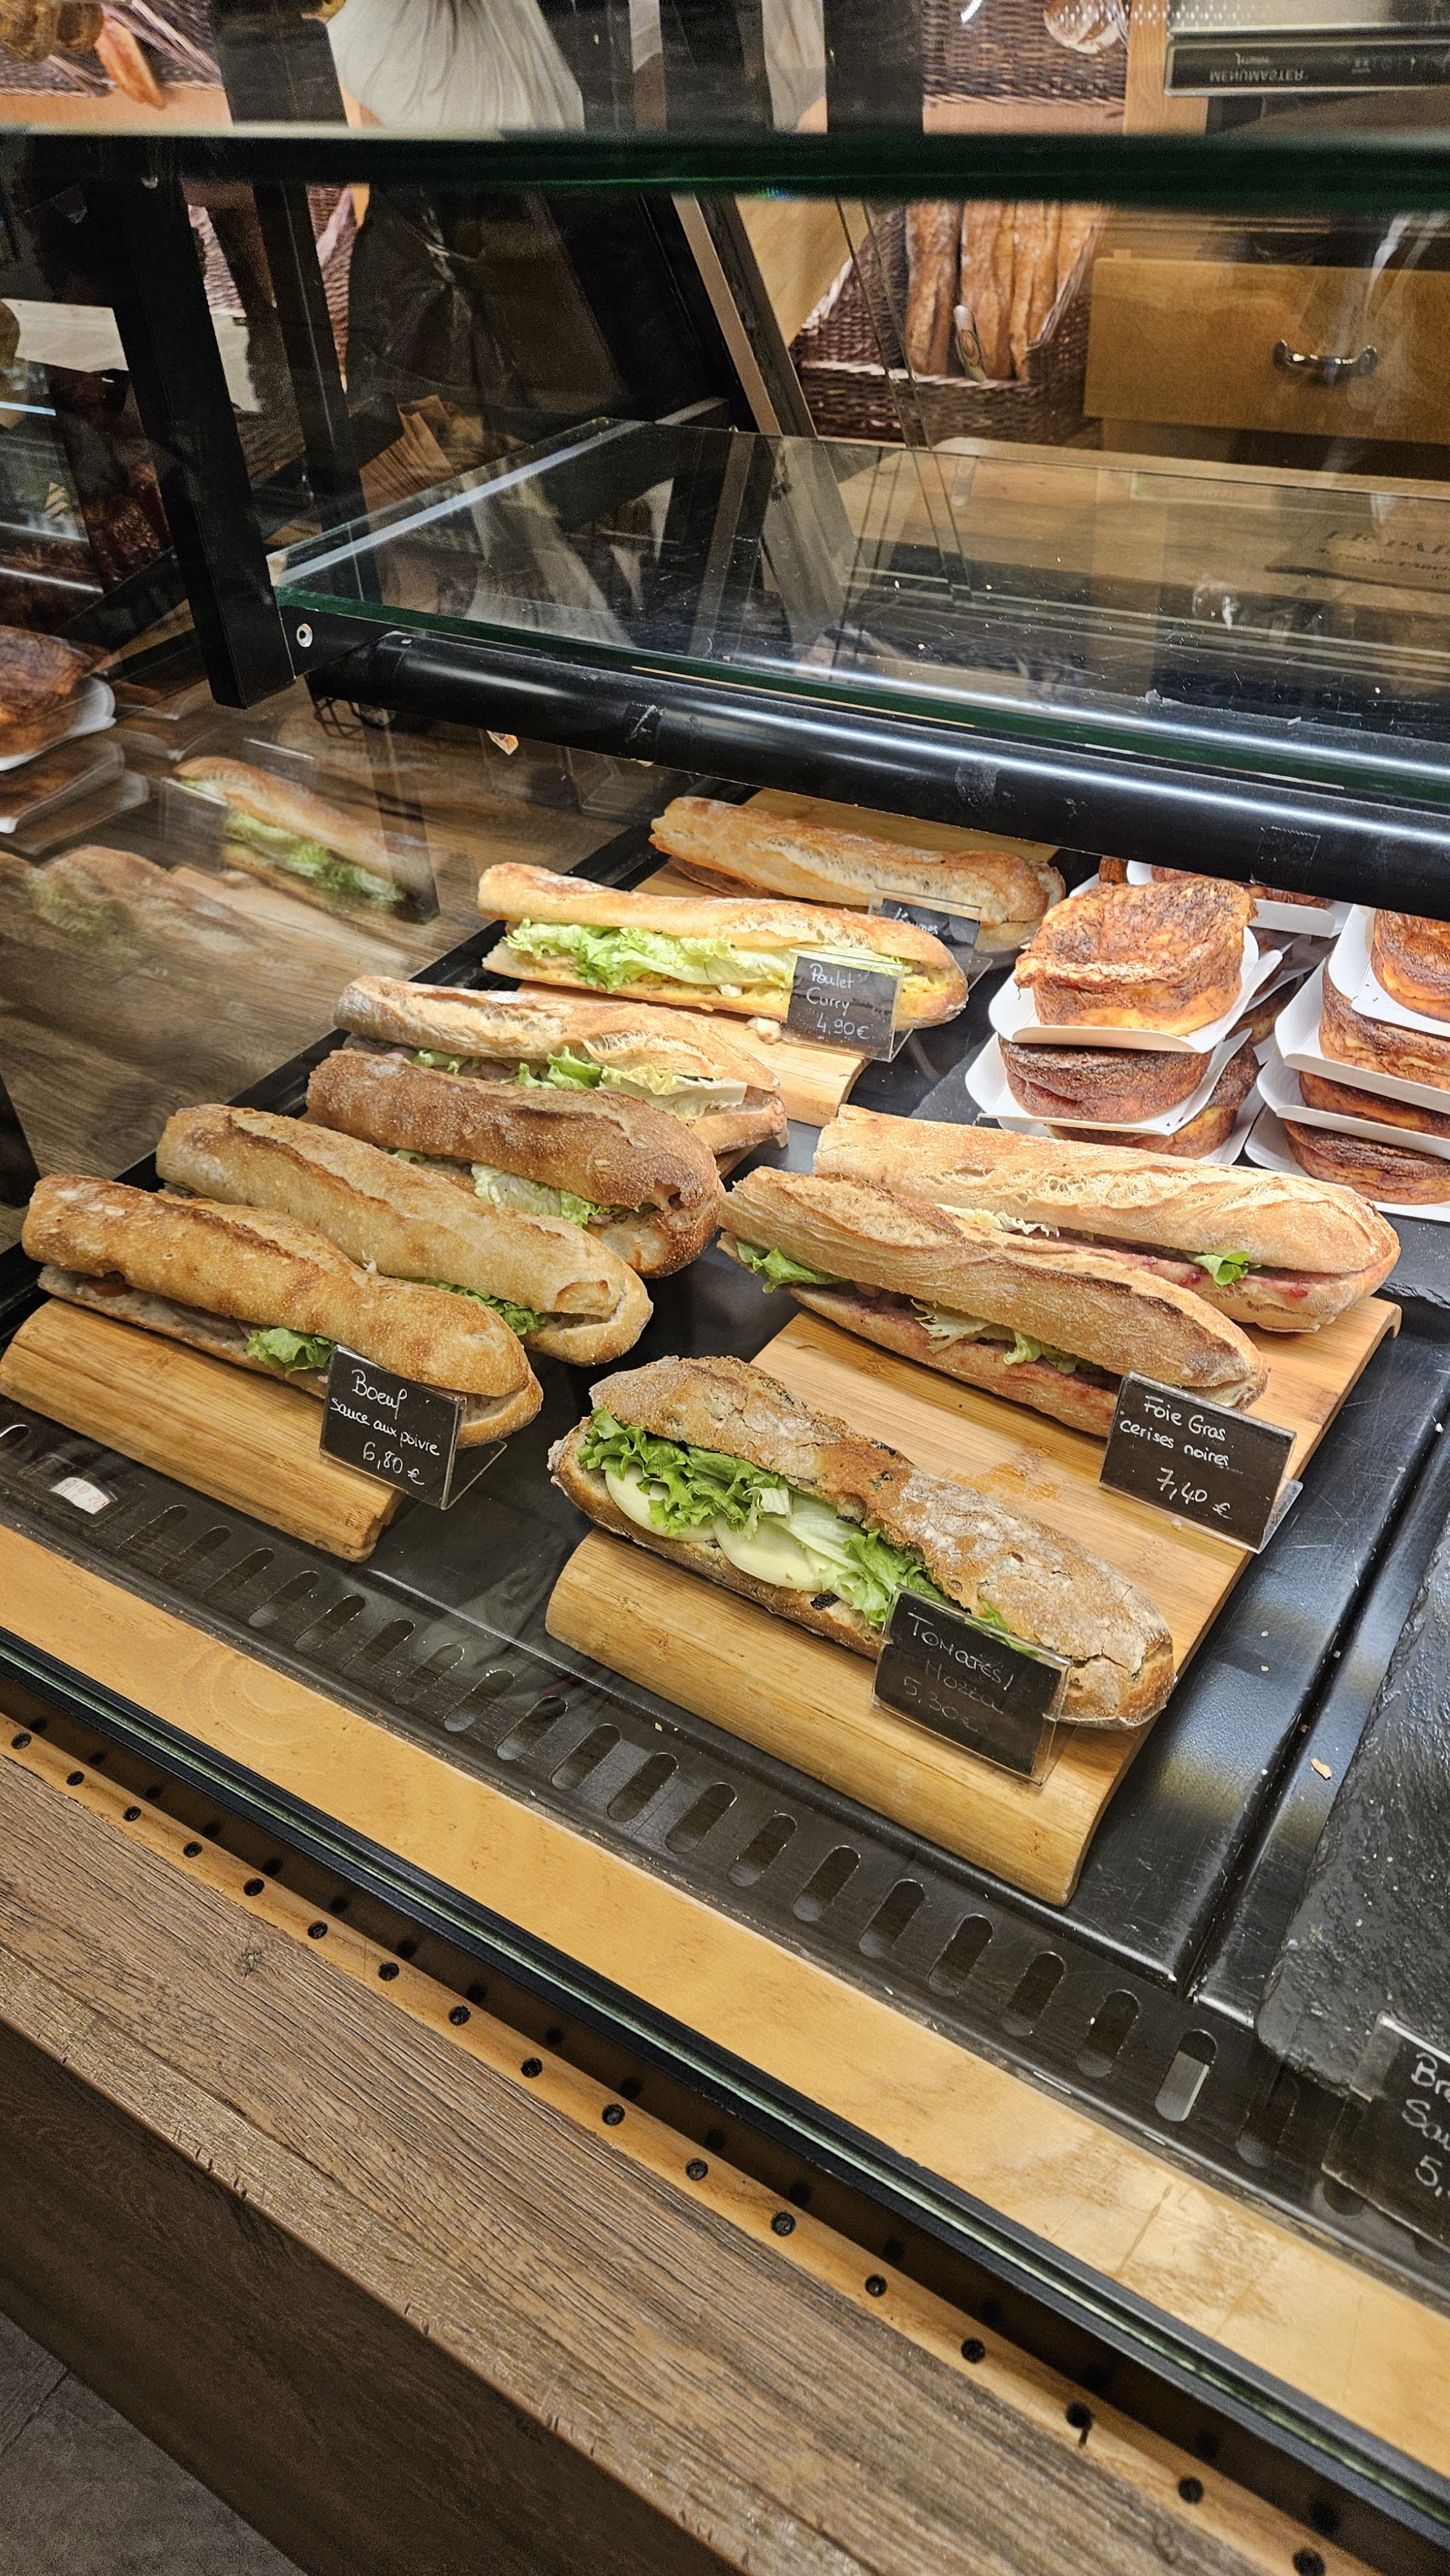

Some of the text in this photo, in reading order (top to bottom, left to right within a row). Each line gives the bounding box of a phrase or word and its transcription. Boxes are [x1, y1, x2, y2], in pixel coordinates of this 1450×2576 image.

[809, 963, 855, 989] Poulet
[805, 987, 850, 1017] Curry
[351, 1369, 408, 1420] Boeuf
[330, 1397, 440, 1456] sauce aux poivre
[1144, 1395, 1226, 1441] Foie Gras
[362, 1441, 426, 1486] 6,80 €
[1183, 1444, 1230, 1466] noires
[1156, 1467, 1232, 1520] 7,40 €
[1415, 2155, 1450, 2197] 5,
